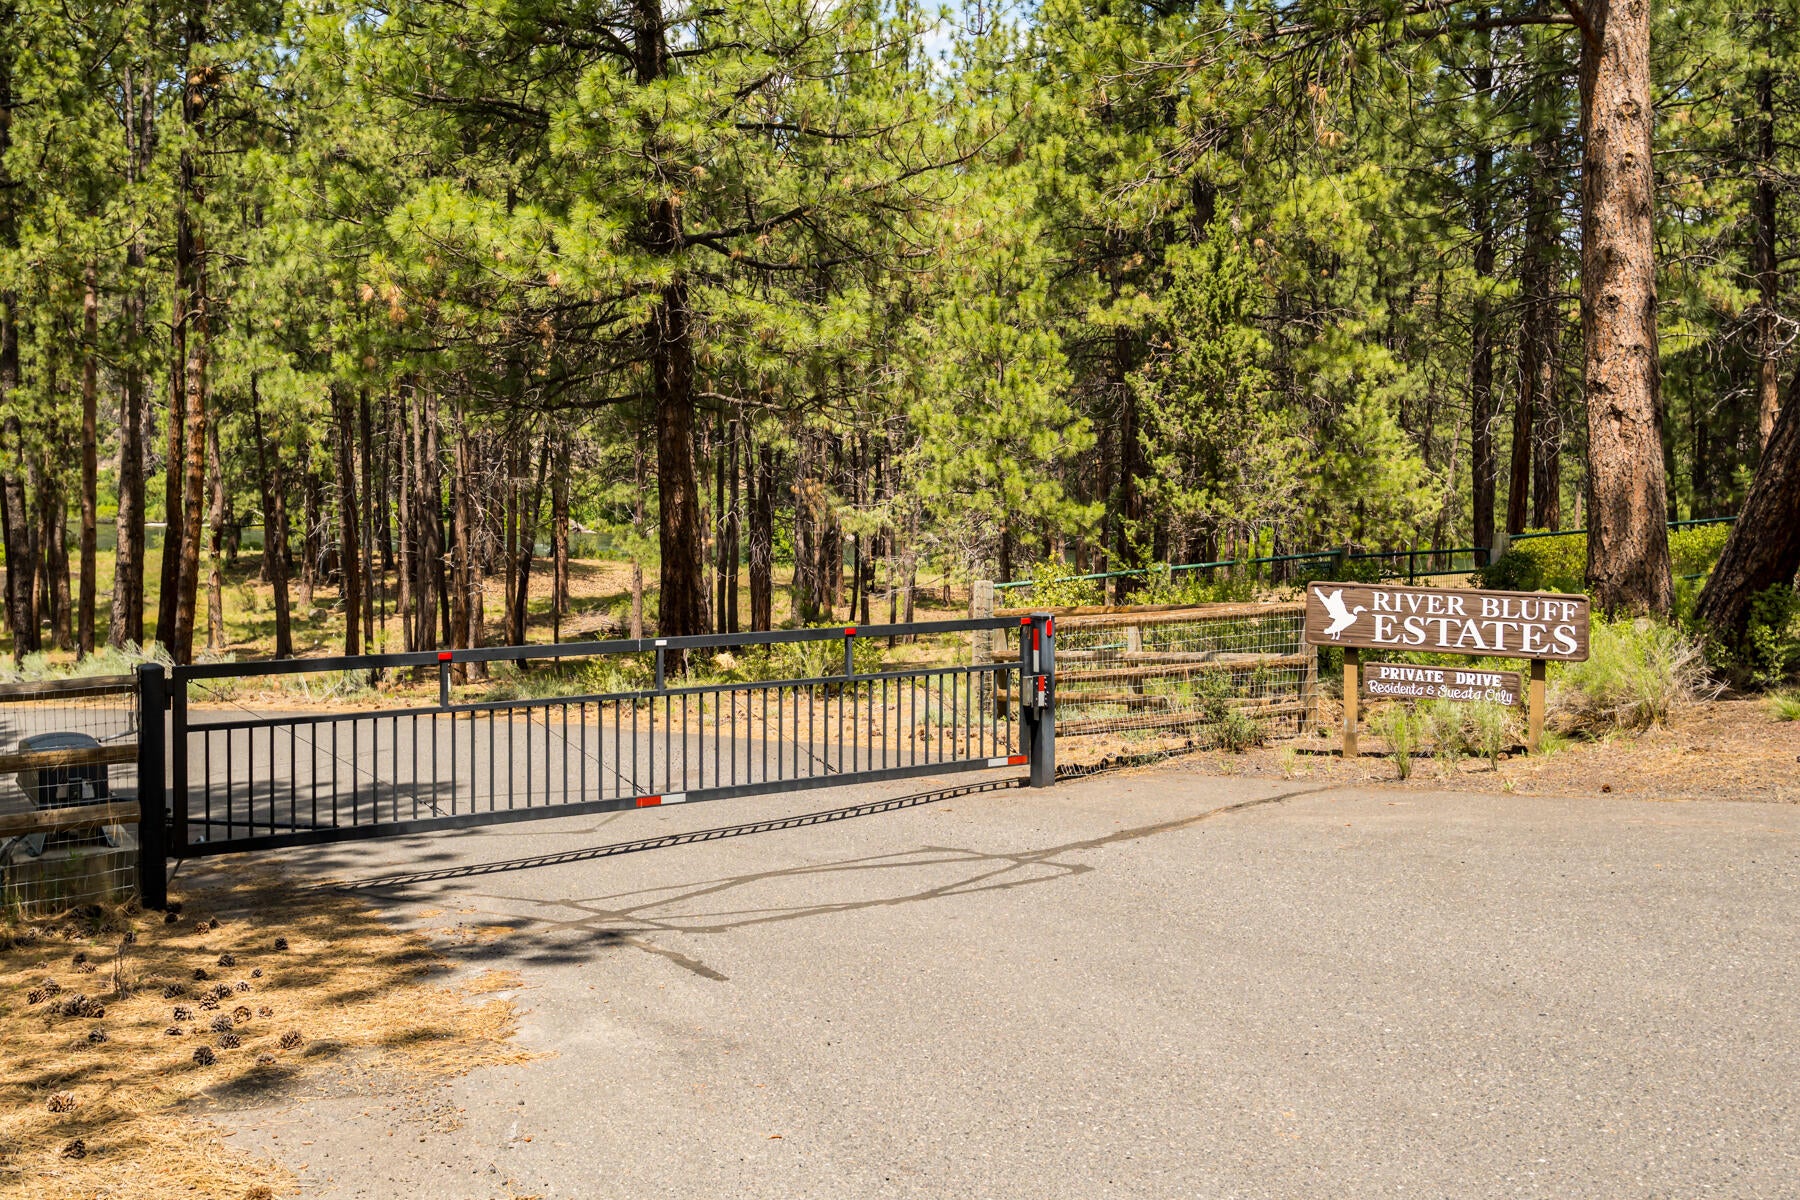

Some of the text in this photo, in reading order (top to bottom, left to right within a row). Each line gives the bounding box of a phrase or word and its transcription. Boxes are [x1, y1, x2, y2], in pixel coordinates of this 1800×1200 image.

[1372, 591, 1578, 622] RIVER BLUFF
[1372, 614, 1578, 655] ESTATES
[1379, 666, 1503, 687] PRIVATE DRIVE
[1367, 679, 1424, 697] Residents
[1426, 685, 1435, 695] &
[1485, 689, 1514, 705] Only
